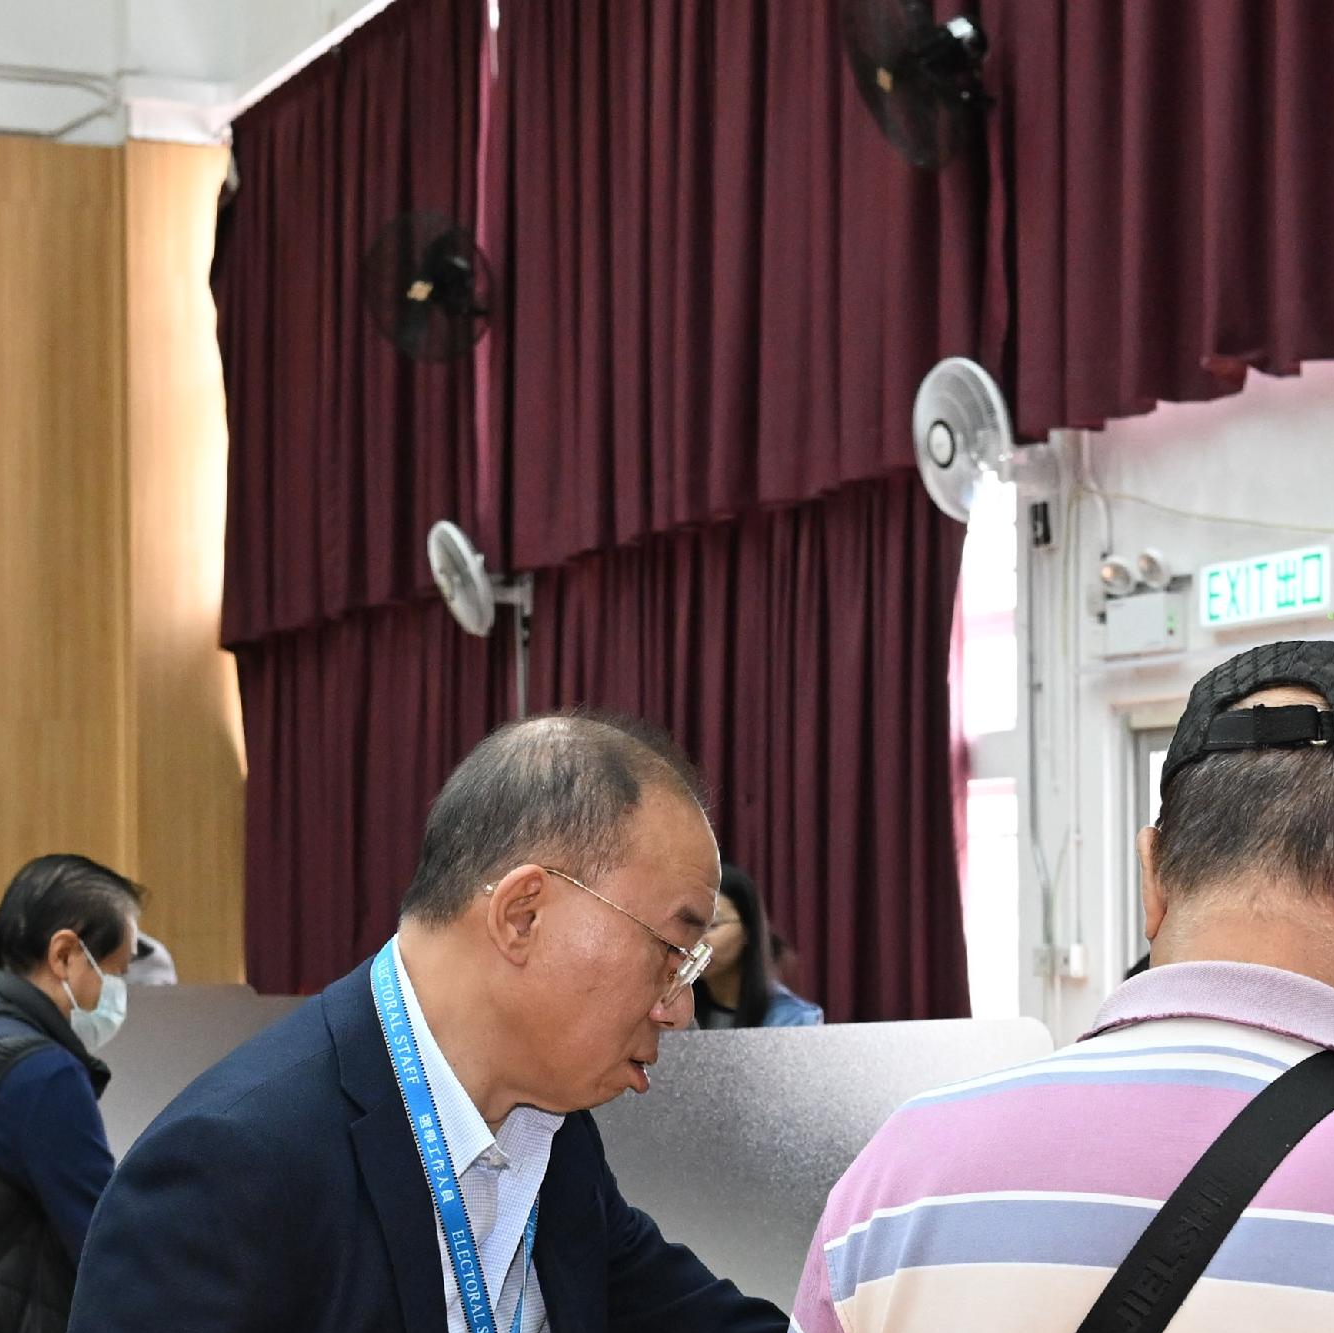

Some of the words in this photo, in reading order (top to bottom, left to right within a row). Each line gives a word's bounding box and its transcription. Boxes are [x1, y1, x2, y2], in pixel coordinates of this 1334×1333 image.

[1209, 563, 1267, 621] EXIT
[1277, 553, 1323, 608] 出口
[395, 1034, 420, 1085] STAFF
[452, 1229, 484, 1324] ELECTORAL
